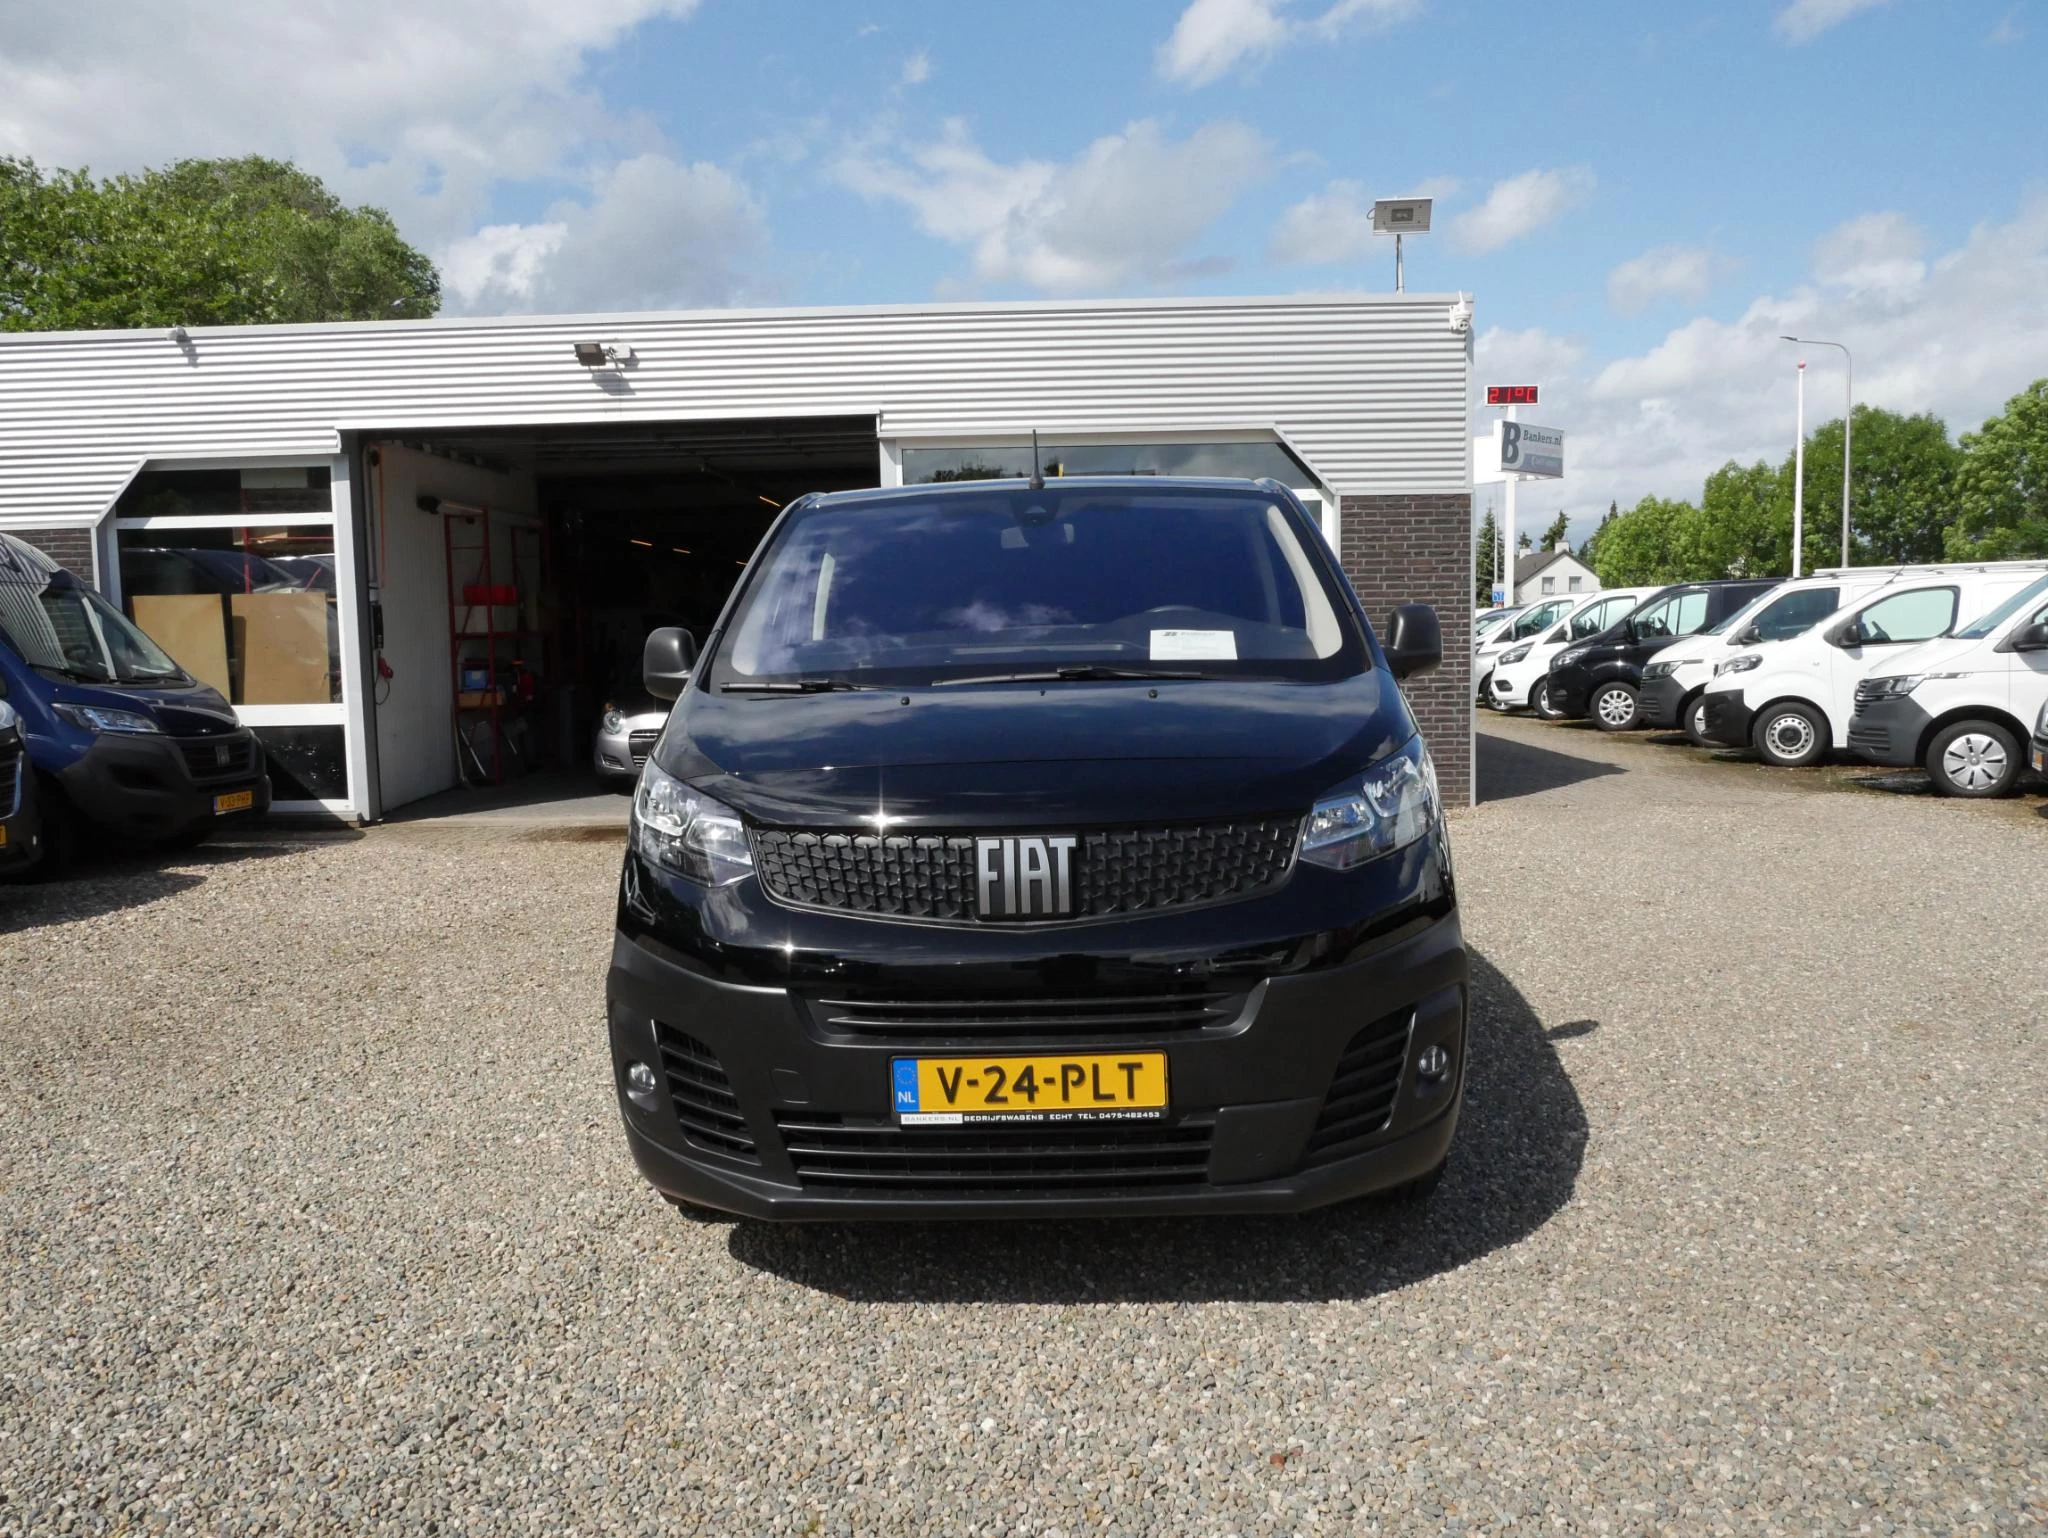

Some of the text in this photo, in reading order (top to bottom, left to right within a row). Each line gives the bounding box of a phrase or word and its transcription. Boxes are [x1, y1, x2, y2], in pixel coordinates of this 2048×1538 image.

[977, 837, 1077, 915] FIAT
[936, 1062, 1143, 1104] V-24-PLT
[898, 1091, 915, 1102] NL
[964, 1114, 1044, 1122] BEDRIJFSWAGENS
[1049, 1113, 1073, 1121] ECHT
[1078, 1112, 1097, 1120] TEL.
